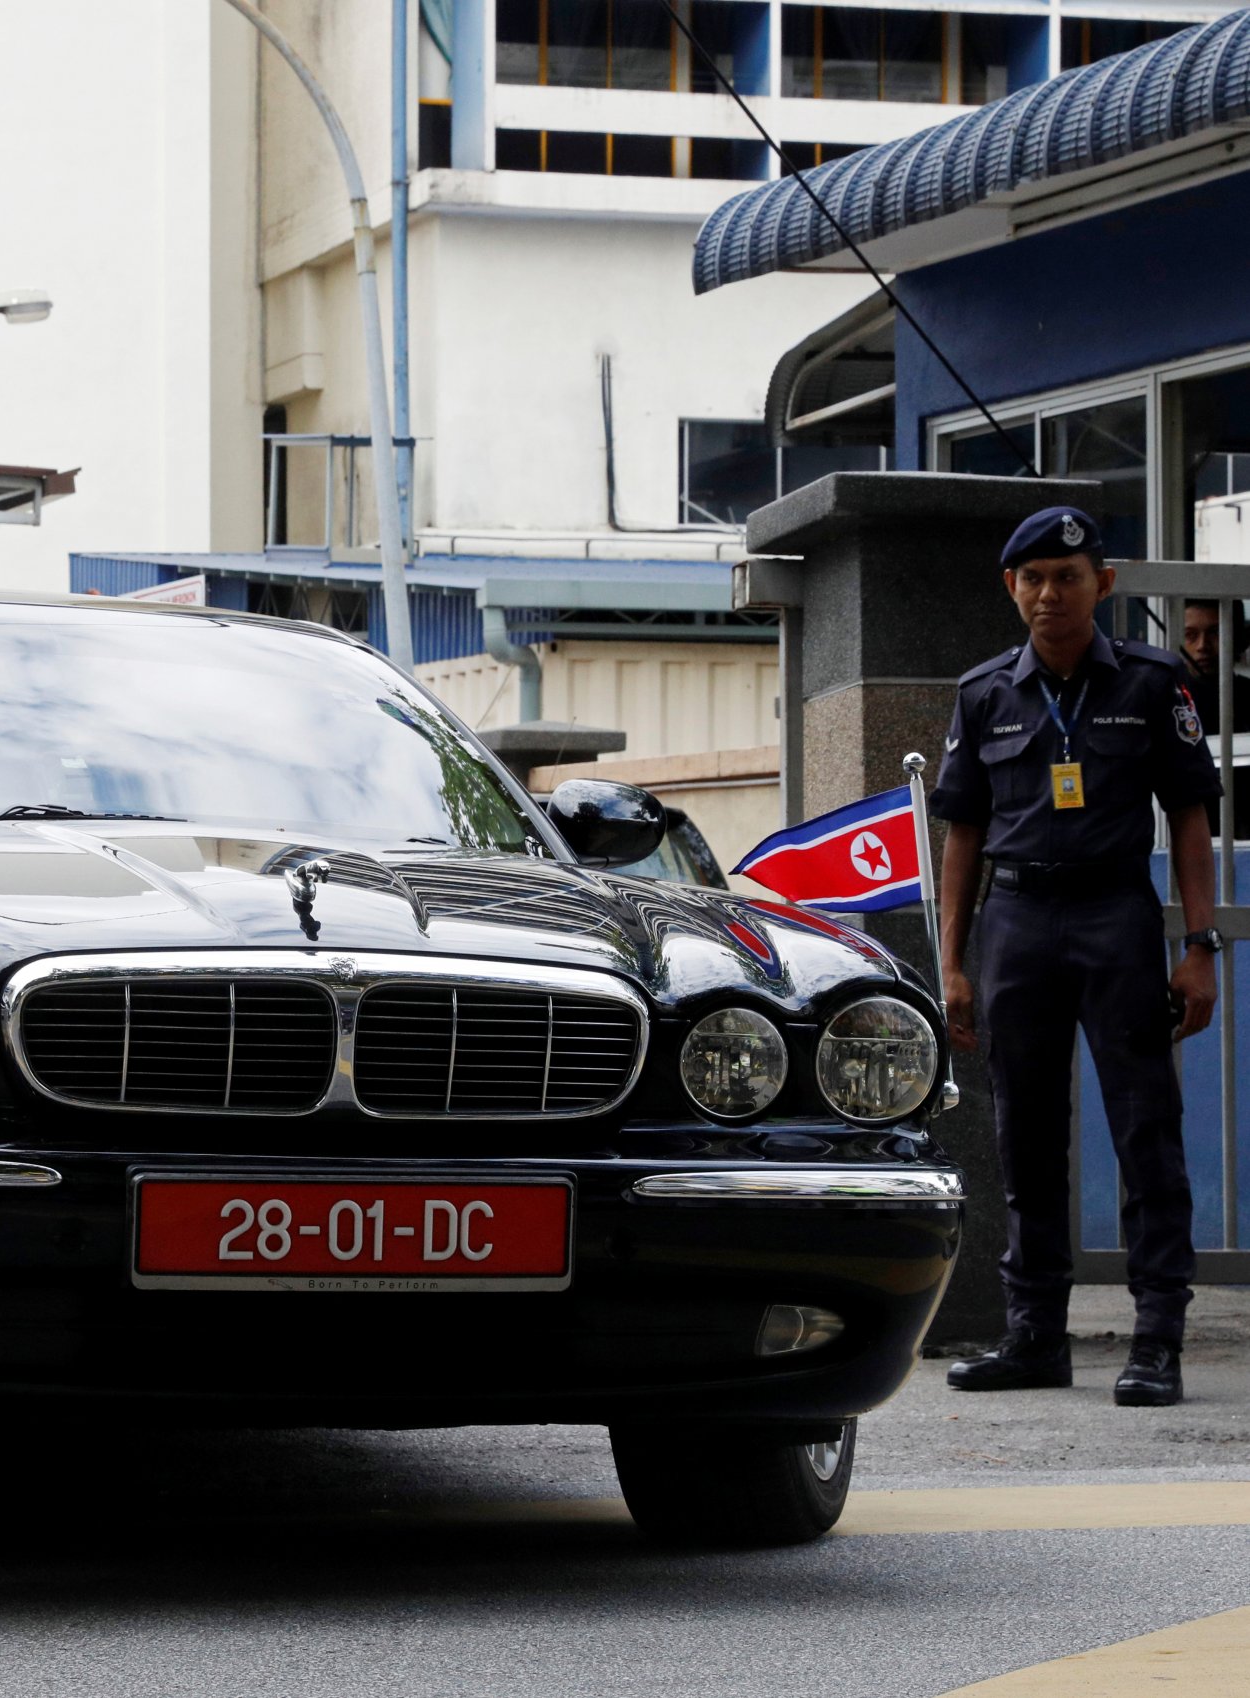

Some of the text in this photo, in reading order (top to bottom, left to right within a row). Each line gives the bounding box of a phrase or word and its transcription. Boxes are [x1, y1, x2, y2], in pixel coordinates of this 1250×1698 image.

[218, 1199, 495, 1261] 28-01-DC
[308, 1279, 438, 1290] Born To Perform
